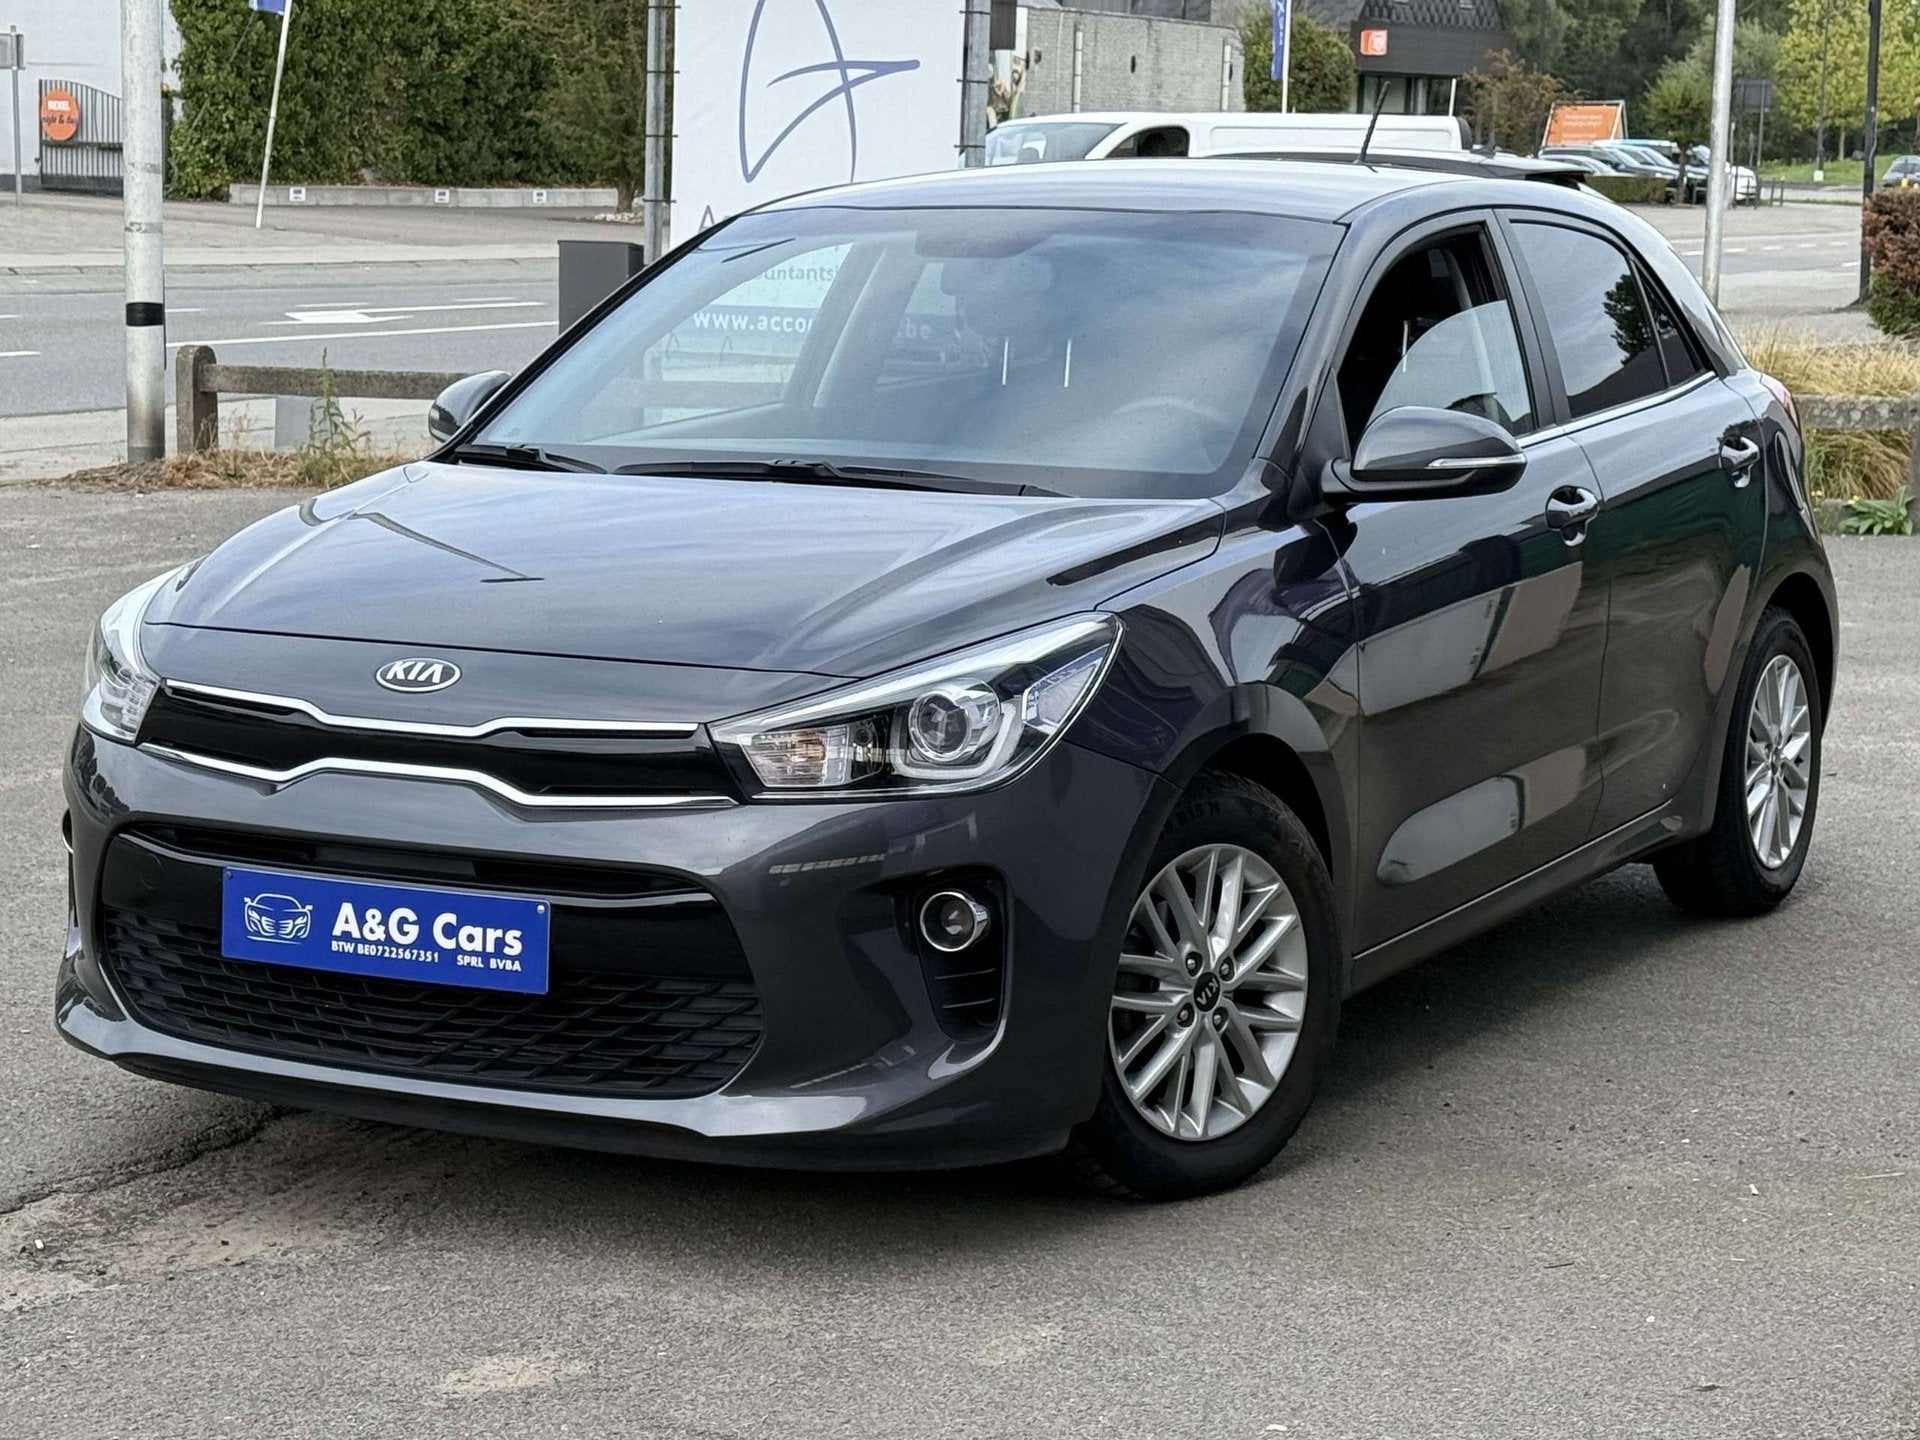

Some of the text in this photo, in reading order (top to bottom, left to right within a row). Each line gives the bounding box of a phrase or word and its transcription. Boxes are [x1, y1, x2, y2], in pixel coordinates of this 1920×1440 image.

[754, 264, 839, 282] untants
[385, 661, 444, 684] KIA
[331, 901, 523, 956] A&G Cars
[331, 940, 522, 972] BTW BE0722567351 SPRL BVBA
[1196, 977, 1219, 1006] KIA
